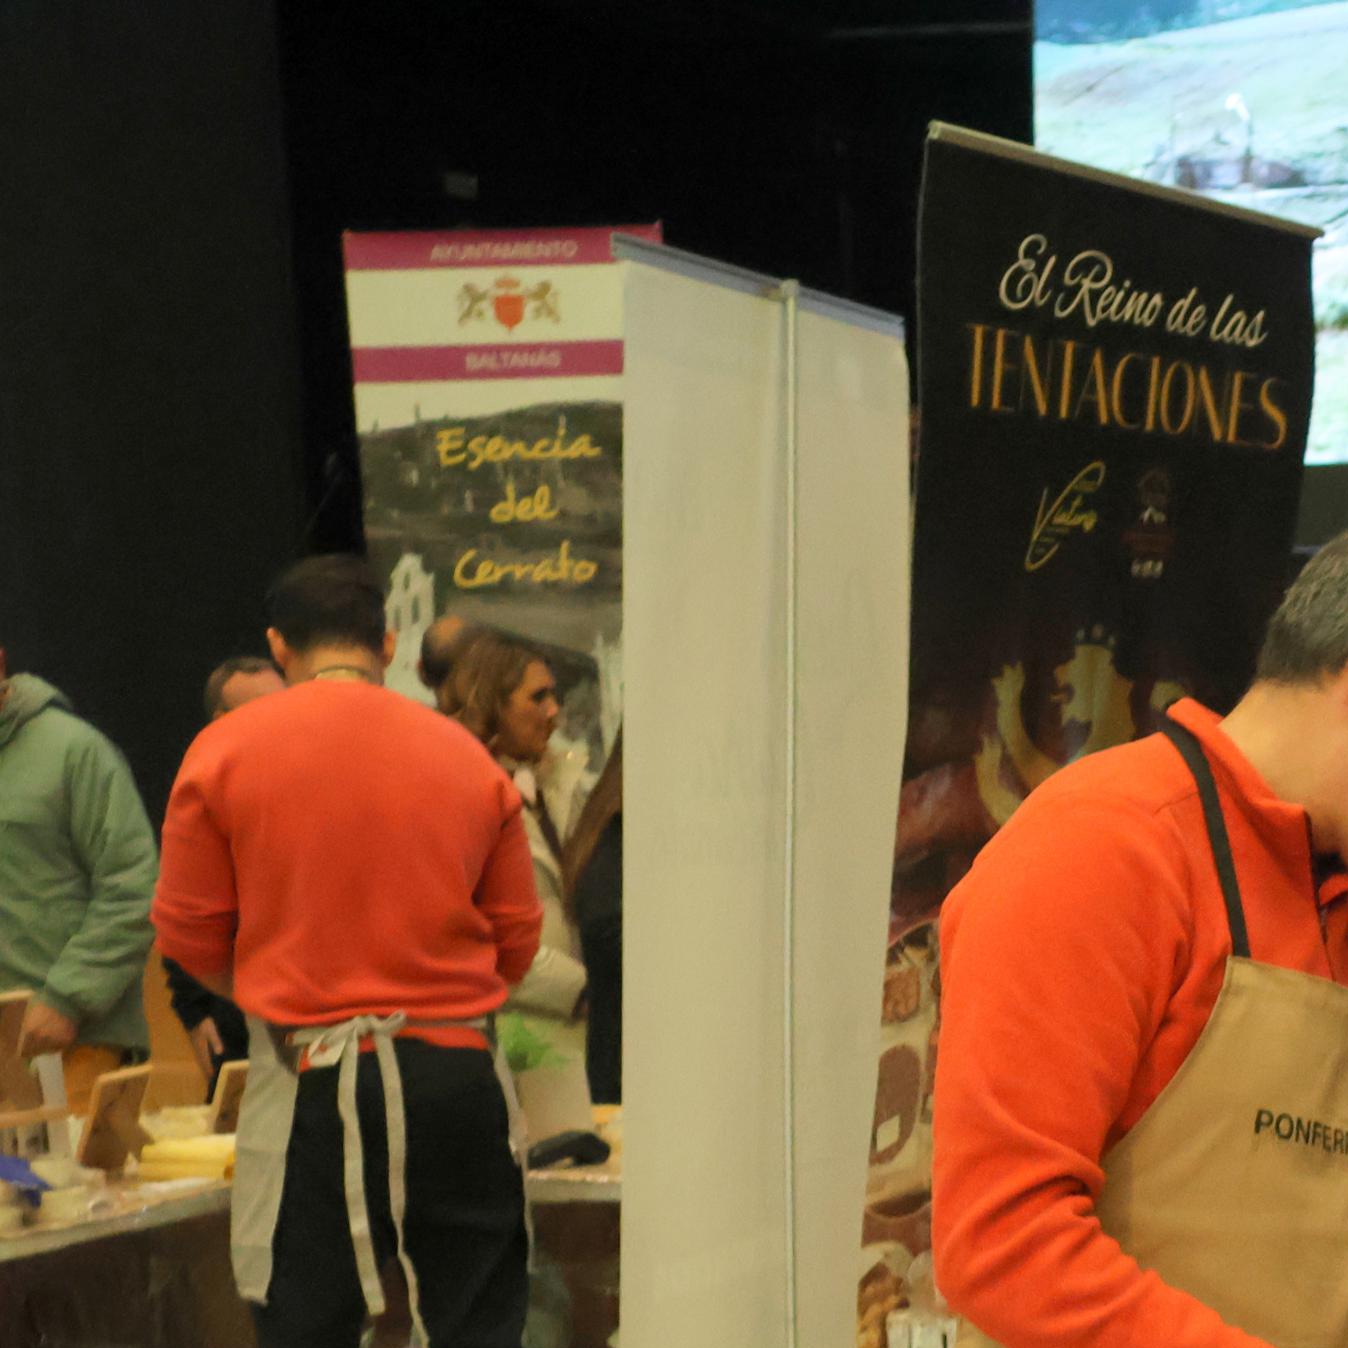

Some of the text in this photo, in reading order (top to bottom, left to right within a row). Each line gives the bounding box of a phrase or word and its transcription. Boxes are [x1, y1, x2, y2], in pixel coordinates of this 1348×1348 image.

[429, 240, 578, 261] AYUNTAMIENTO
[999, 233, 1270, 348] El Reino de las
[965, 322, 1292, 452] TENTACIONES
[436, 427, 602, 471] Esencia
[489, 484, 559, 524] del
[453, 539, 597, 589] Cerrato
